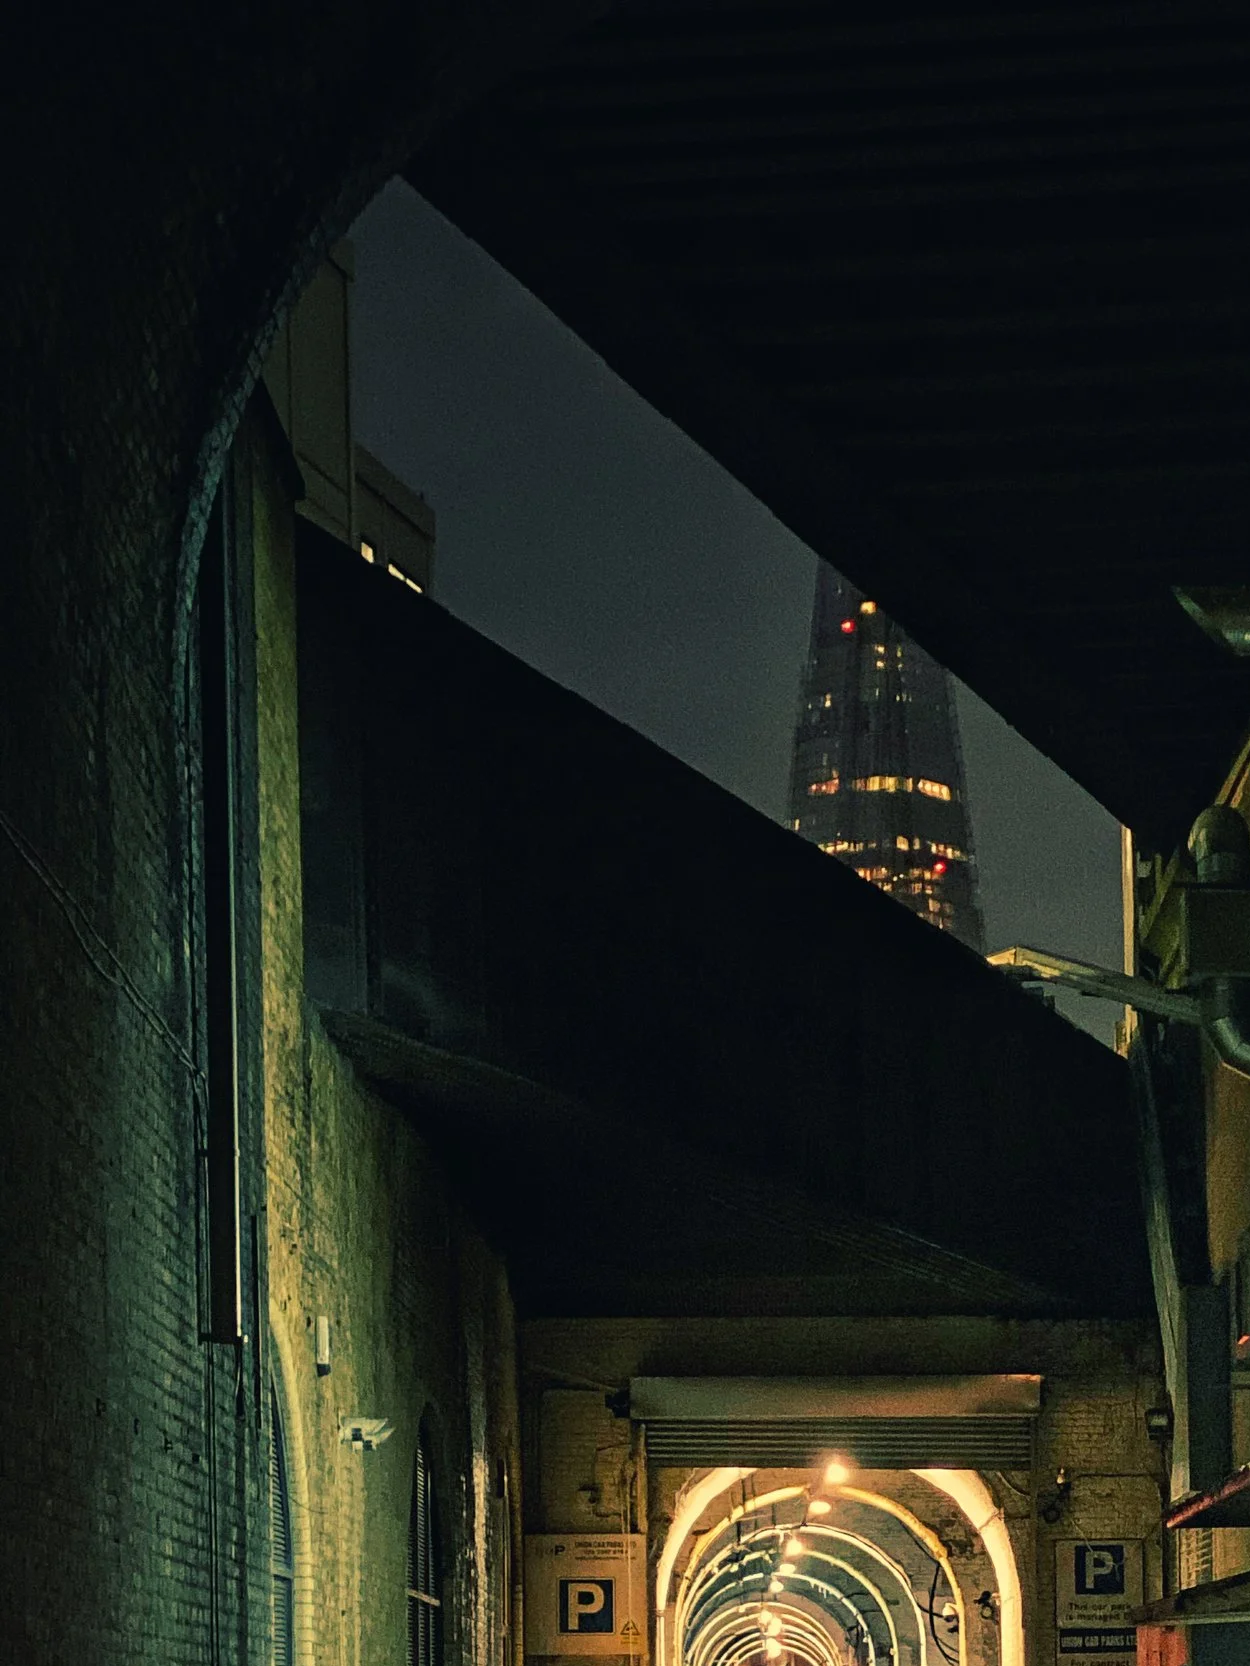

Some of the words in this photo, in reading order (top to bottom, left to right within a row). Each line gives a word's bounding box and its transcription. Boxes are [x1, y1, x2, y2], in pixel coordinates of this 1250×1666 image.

[1085, 1551, 1113, 1589] P
[567, 1583, 605, 1630] P
[1069, 1603, 1088, 1611] This
[1065, 1613, 1073, 1621] is
[1077, 1613, 1121, 1623] managed
[1084, 1635, 1099, 1648] CAR
[1101, 1635, 1125, 1647] PARKS
